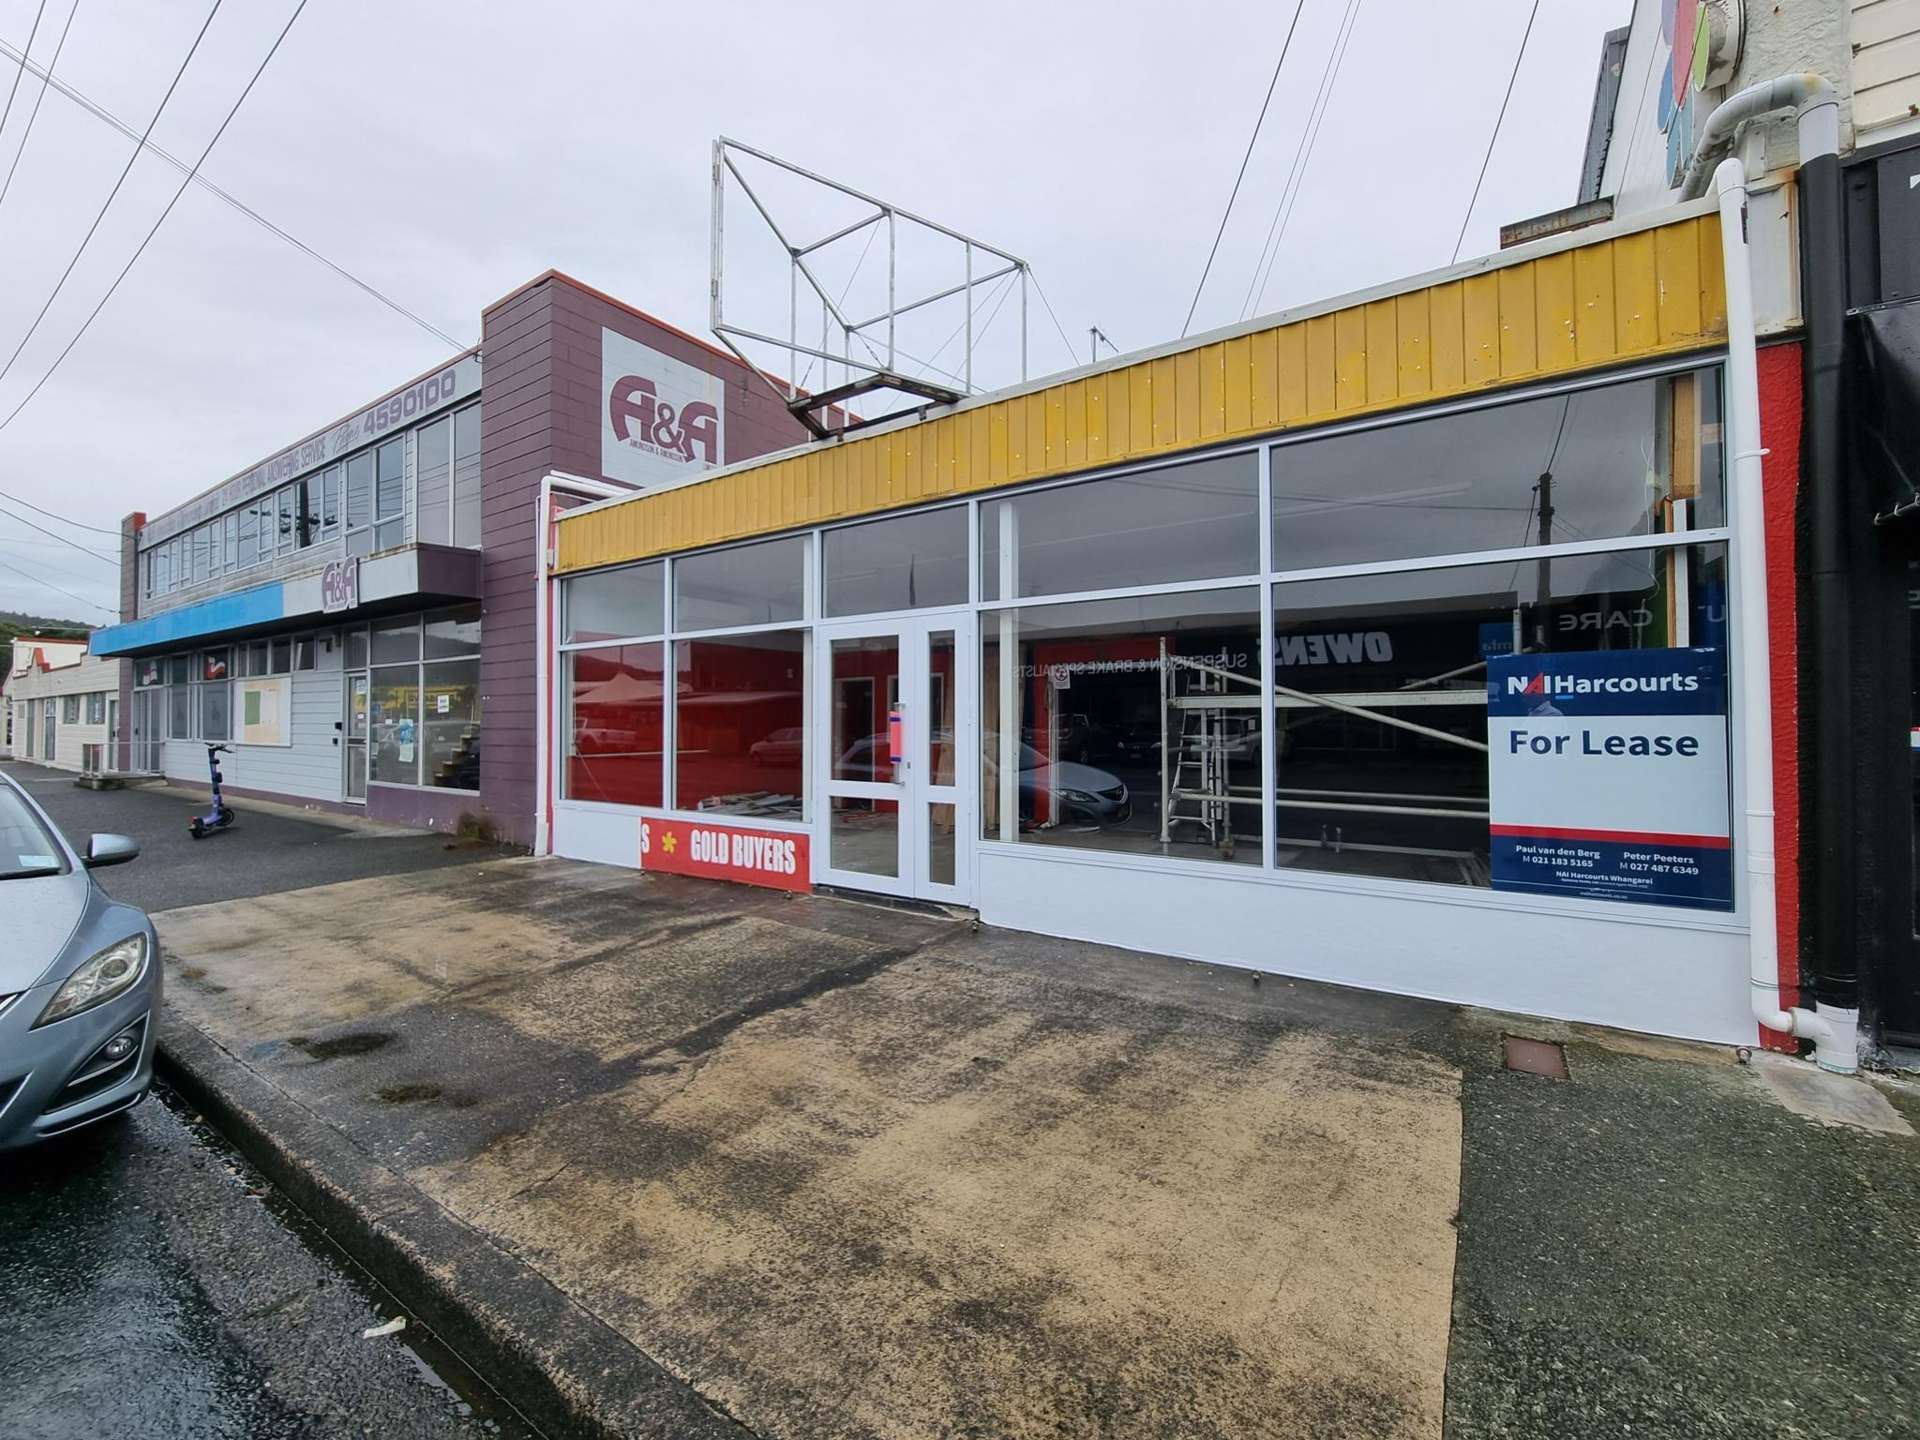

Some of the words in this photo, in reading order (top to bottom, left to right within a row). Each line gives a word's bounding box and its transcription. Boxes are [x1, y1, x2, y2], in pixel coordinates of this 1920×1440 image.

[364, 369, 456, 434] 4590100
[610, 375, 719, 464] A&A
[1510, 730, 1570, 754] For
[1582, 730, 1699, 757] Lease
[691, 829, 728, 864] GOLD
[732, 834, 796, 874] BUYERS
[1516, 845, 1537, 854] Paul
[1557, 847, 1575, 856] den
[1578, 849, 1601, 860] Berg
[1624, 852, 1651, 861] Peter
[1654, 853, 1694, 864] Peeters
[1571, 871, 1609, 881] Harcourts
[1610, 874, 1653, 885] Whangarei
[1630, 863, 1648, 871] 027
[1651, 864, 1669, 873] 487
[1672, 866, 1699, 875] 6349
